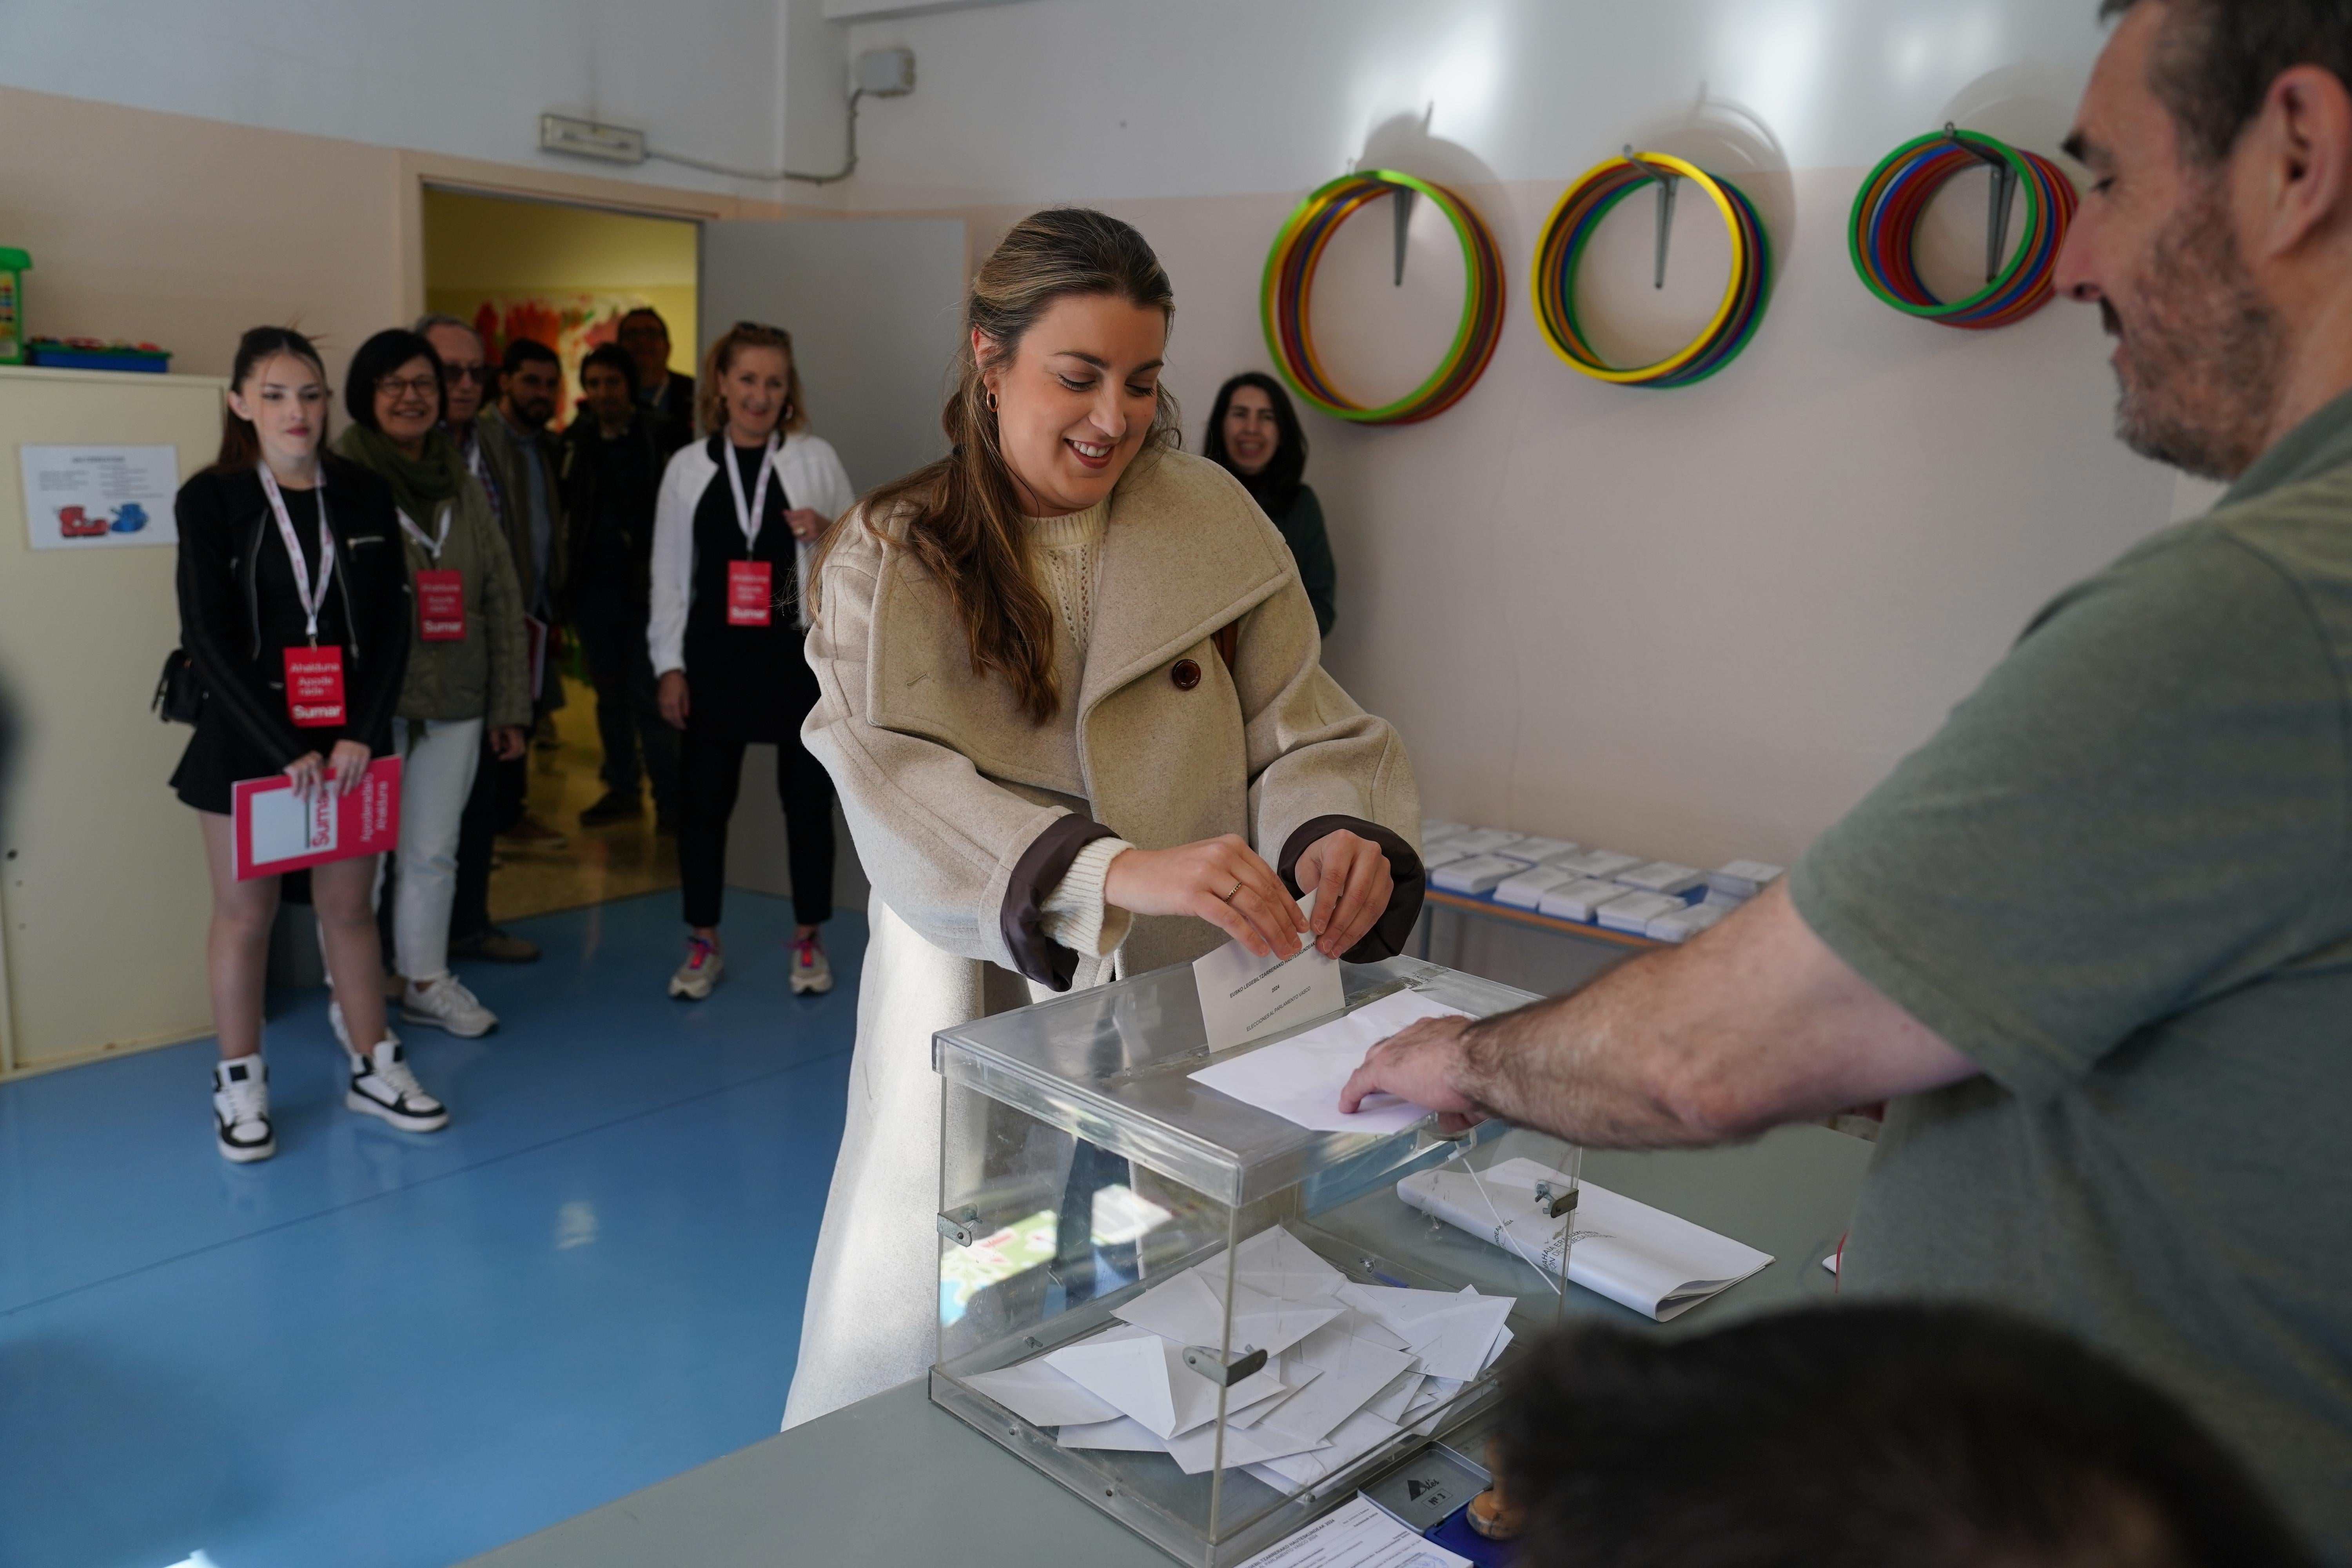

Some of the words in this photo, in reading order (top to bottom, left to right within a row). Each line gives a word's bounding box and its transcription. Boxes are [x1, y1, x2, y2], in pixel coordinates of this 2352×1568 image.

[425, 619, 461, 633] Sumar
[292, 705, 342, 720] Sumar
[1229, 986, 1243, 998] EUSKO
[1243, 961, 1284, 990] LEGEBILTZARRERAKO
[1284, 941, 1316, 964] HAUTESKUNDEAK
[1271, 984, 1279, 993] 2024
[1246, 1013, 1270, 1032] ELECCIONES
[1274, 994, 1299, 1013] PARLAMENTO
[1298, 986, 1311, 997] VASCO
